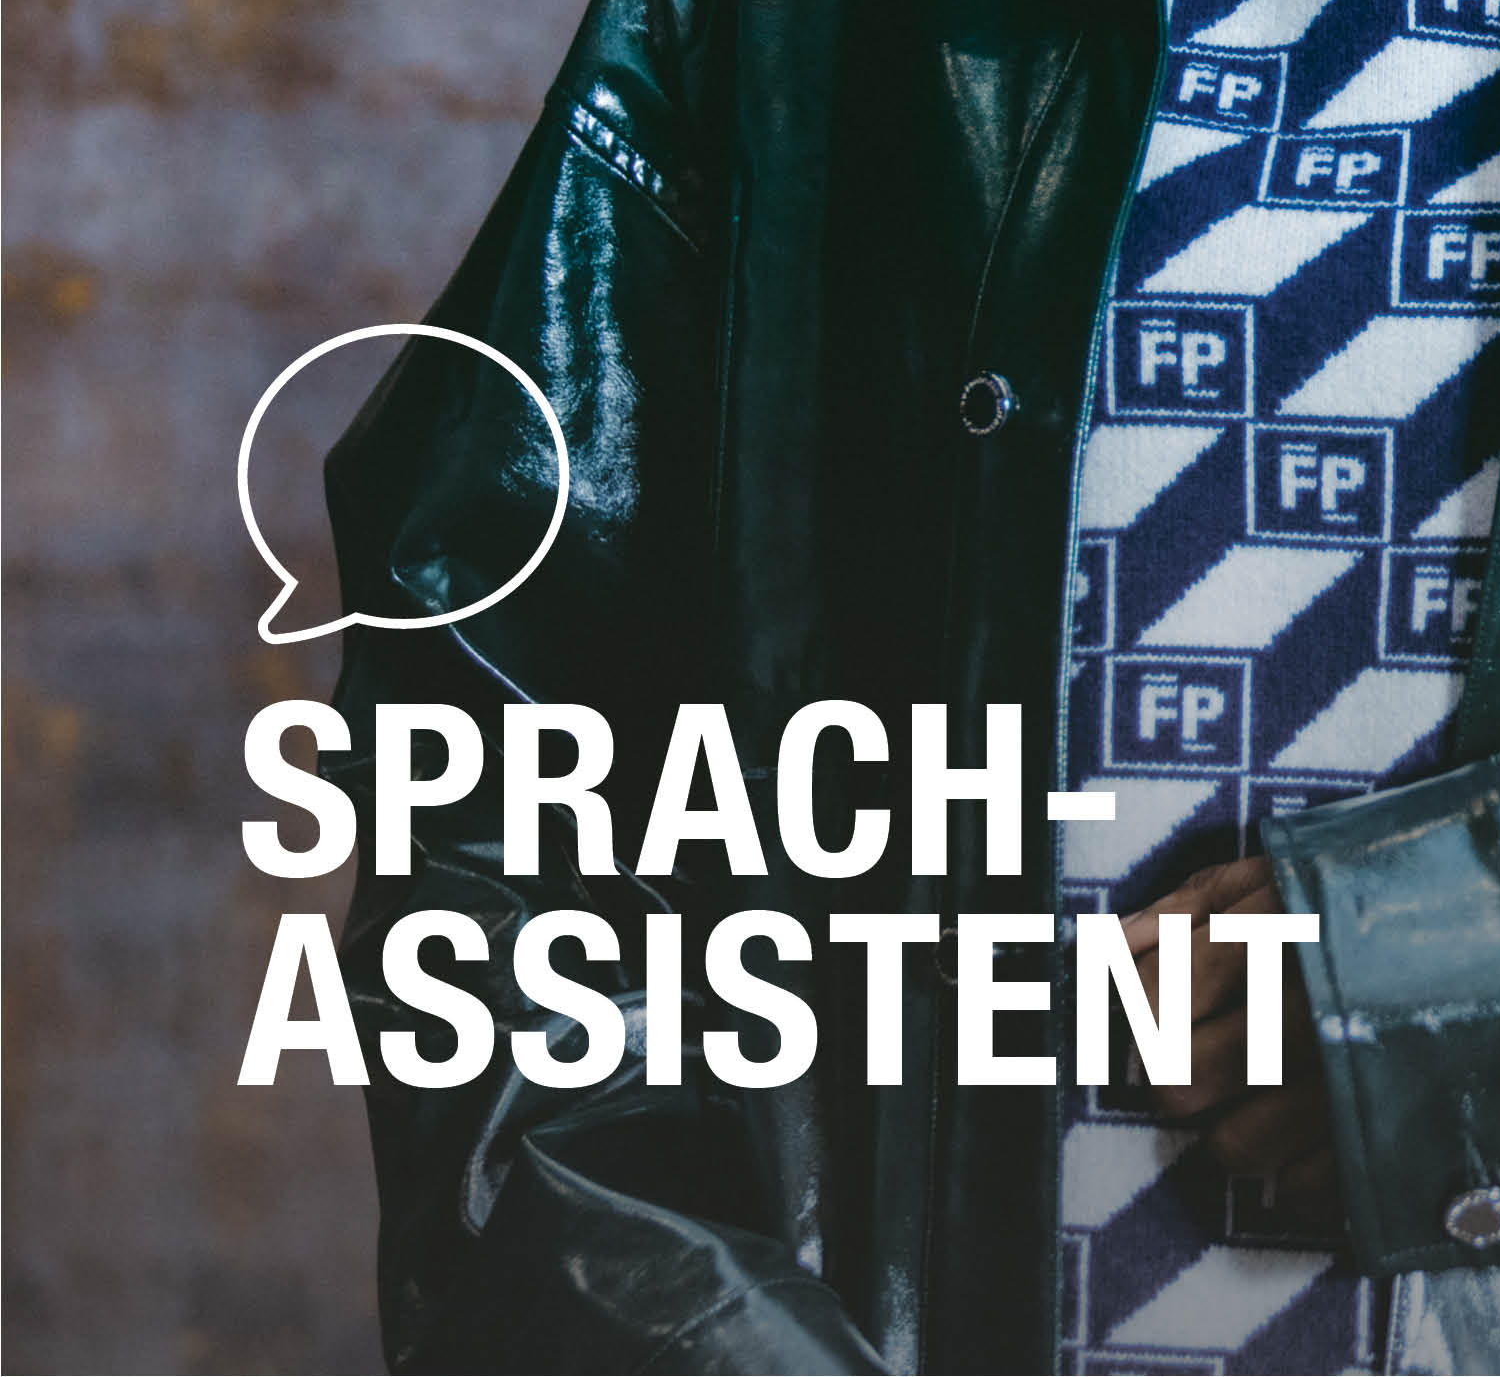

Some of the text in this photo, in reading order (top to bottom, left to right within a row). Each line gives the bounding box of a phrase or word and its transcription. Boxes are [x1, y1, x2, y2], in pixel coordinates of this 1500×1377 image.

[1179, 68, 1262, 109] FP
[1295, 152, 1382, 189] FP
[1139, 330, 1226, 385] FP
[1280, 453, 1366, 511] FP
[1139, 684, 1226, 741] FP
